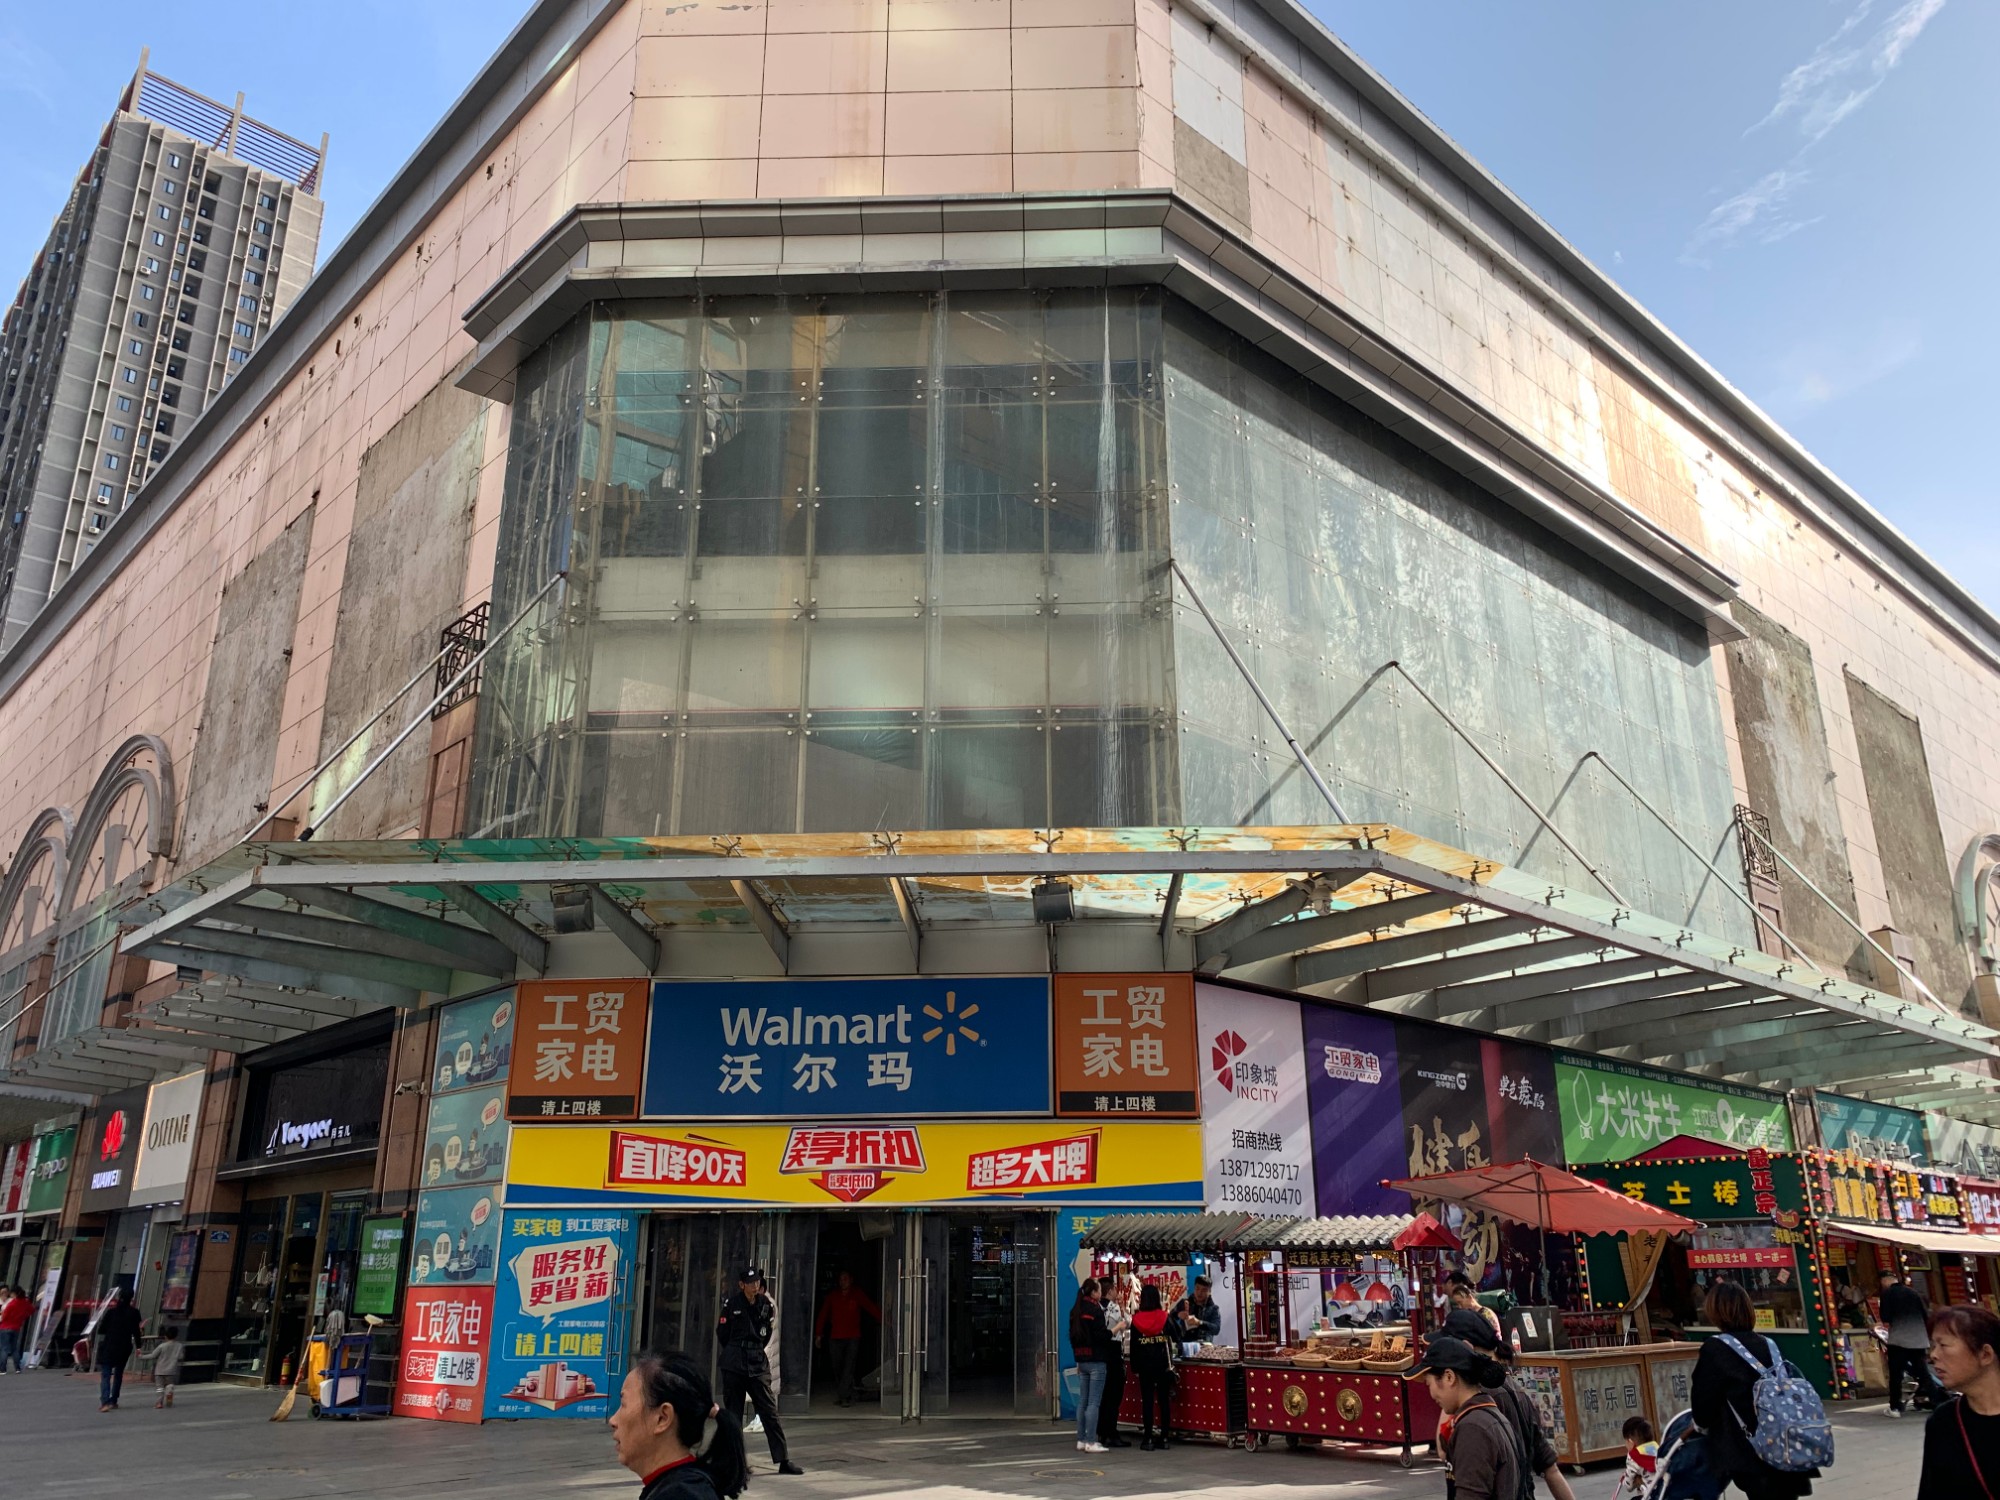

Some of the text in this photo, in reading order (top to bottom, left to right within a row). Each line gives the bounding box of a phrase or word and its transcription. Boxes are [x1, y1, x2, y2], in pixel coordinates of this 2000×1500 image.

[538, 992, 624, 1034] 工贸
[1081, 986, 1166, 1029] 工贸
[720, 1005, 911, 1046] Walmart
[533, 1039, 618, 1082] 家电
[1082, 1033, 1169, 1077] 家电
[1327, 1050, 1378, 1071] 工贸家电
[718, 1052, 912, 1093] 沃尔玛
[1235, 1062, 1278, 1086] 印象城
[1329, 1068, 1379, 1082] GONG MAO
[1094, 1096, 1156, 1111] 请上四楼
[1236, 1085, 1278, 1102] INCITY
[541, 1101, 601, 1115] 请上四楼
[1596, 1081, 1682, 1142] 大米先生
[1231, 1128, 1282, 1152] 招商热线
[620, 1139, 743, 1184] 直降90天
[971, 1141, 1087, 1188] 超多大牌
[1219, 1158, 1299, 1181] 13871298717
[91, 1170, 120, 1190] HUAWEI
[1221, 1184, 1302, 1206] 13886040470
[512, 1218, 629, 1237] 买家电 到工贸家电
[532, 1244, 608, 1279] 服务好
[1288, 1250, 1352, 1266] 迁西板栗专卖
[411, 1300, 482, 1345] 工贸家电
[515, 1333, 603, 1356] 请上四楼
[408, 1356, 435, 1377] 买家电
[1584, 1384, 1638, 1413] 嗨乐园
